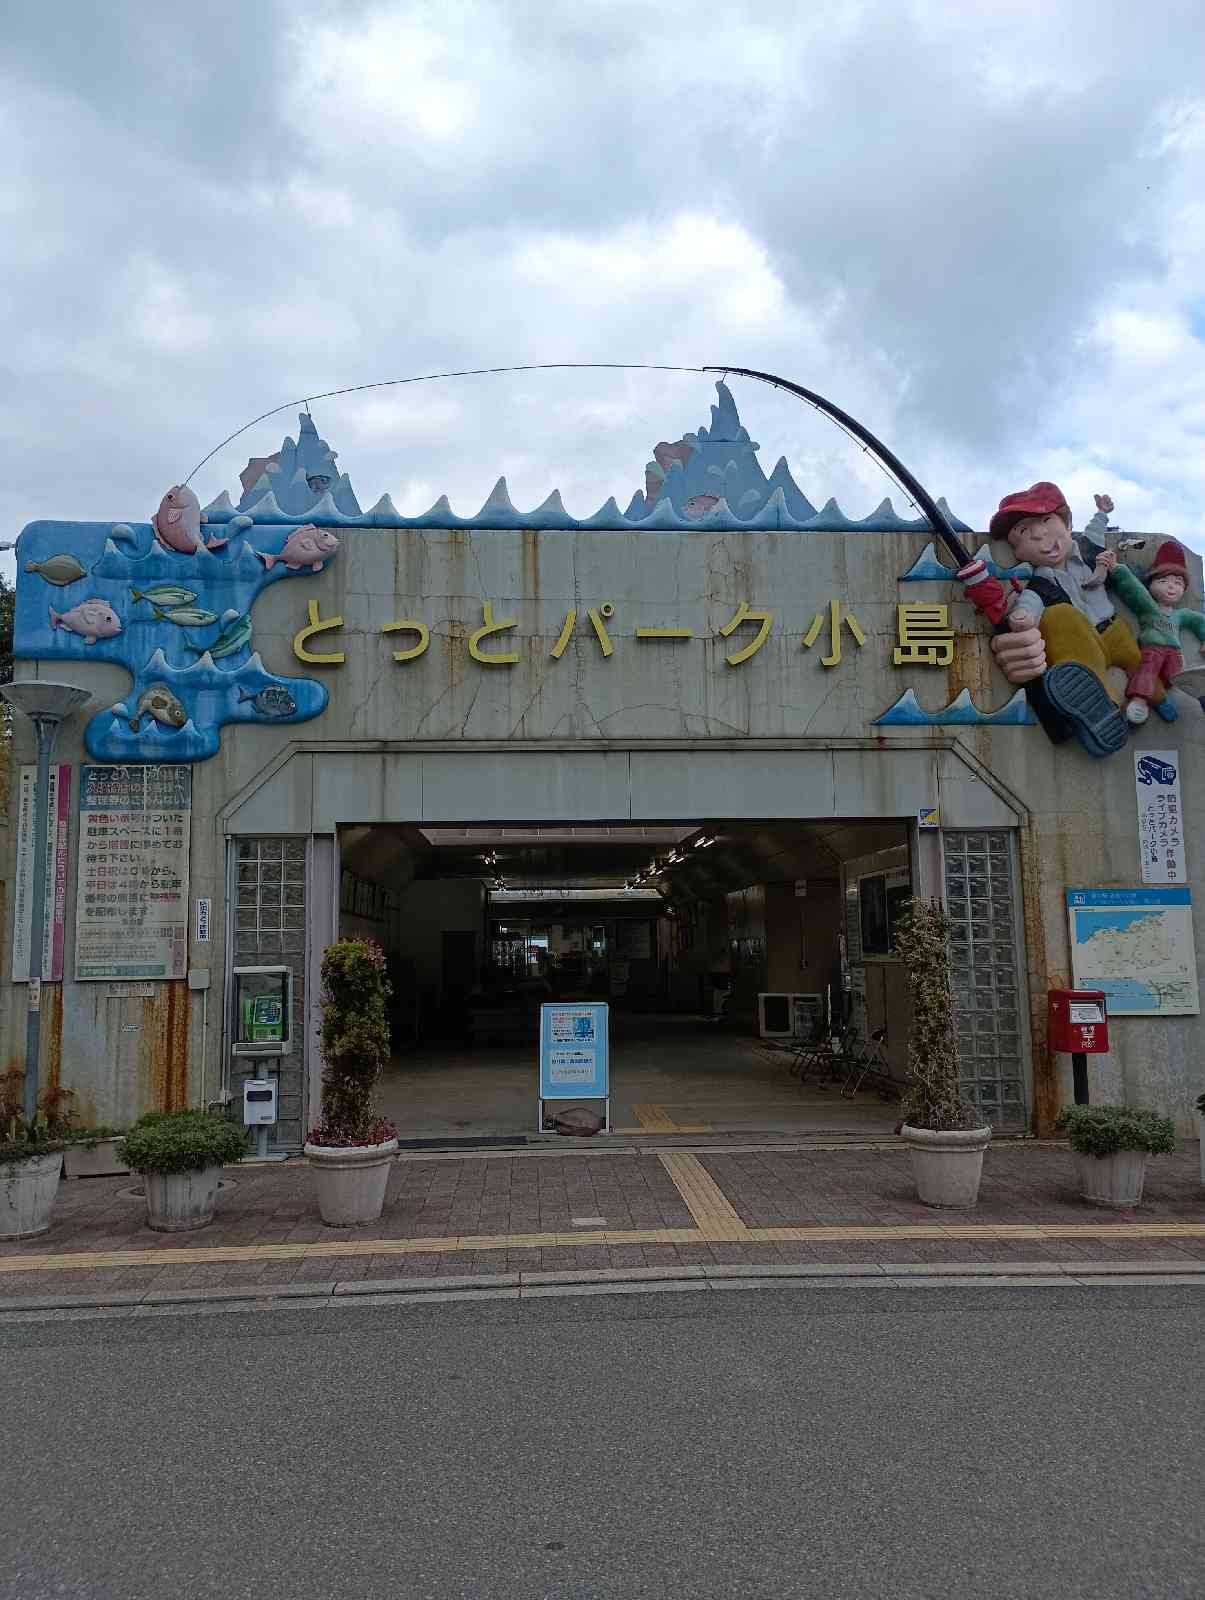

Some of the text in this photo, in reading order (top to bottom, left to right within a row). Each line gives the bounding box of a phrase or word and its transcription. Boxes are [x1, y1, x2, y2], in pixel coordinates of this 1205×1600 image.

[293, 599, 955, 667] とっとパーク小島
